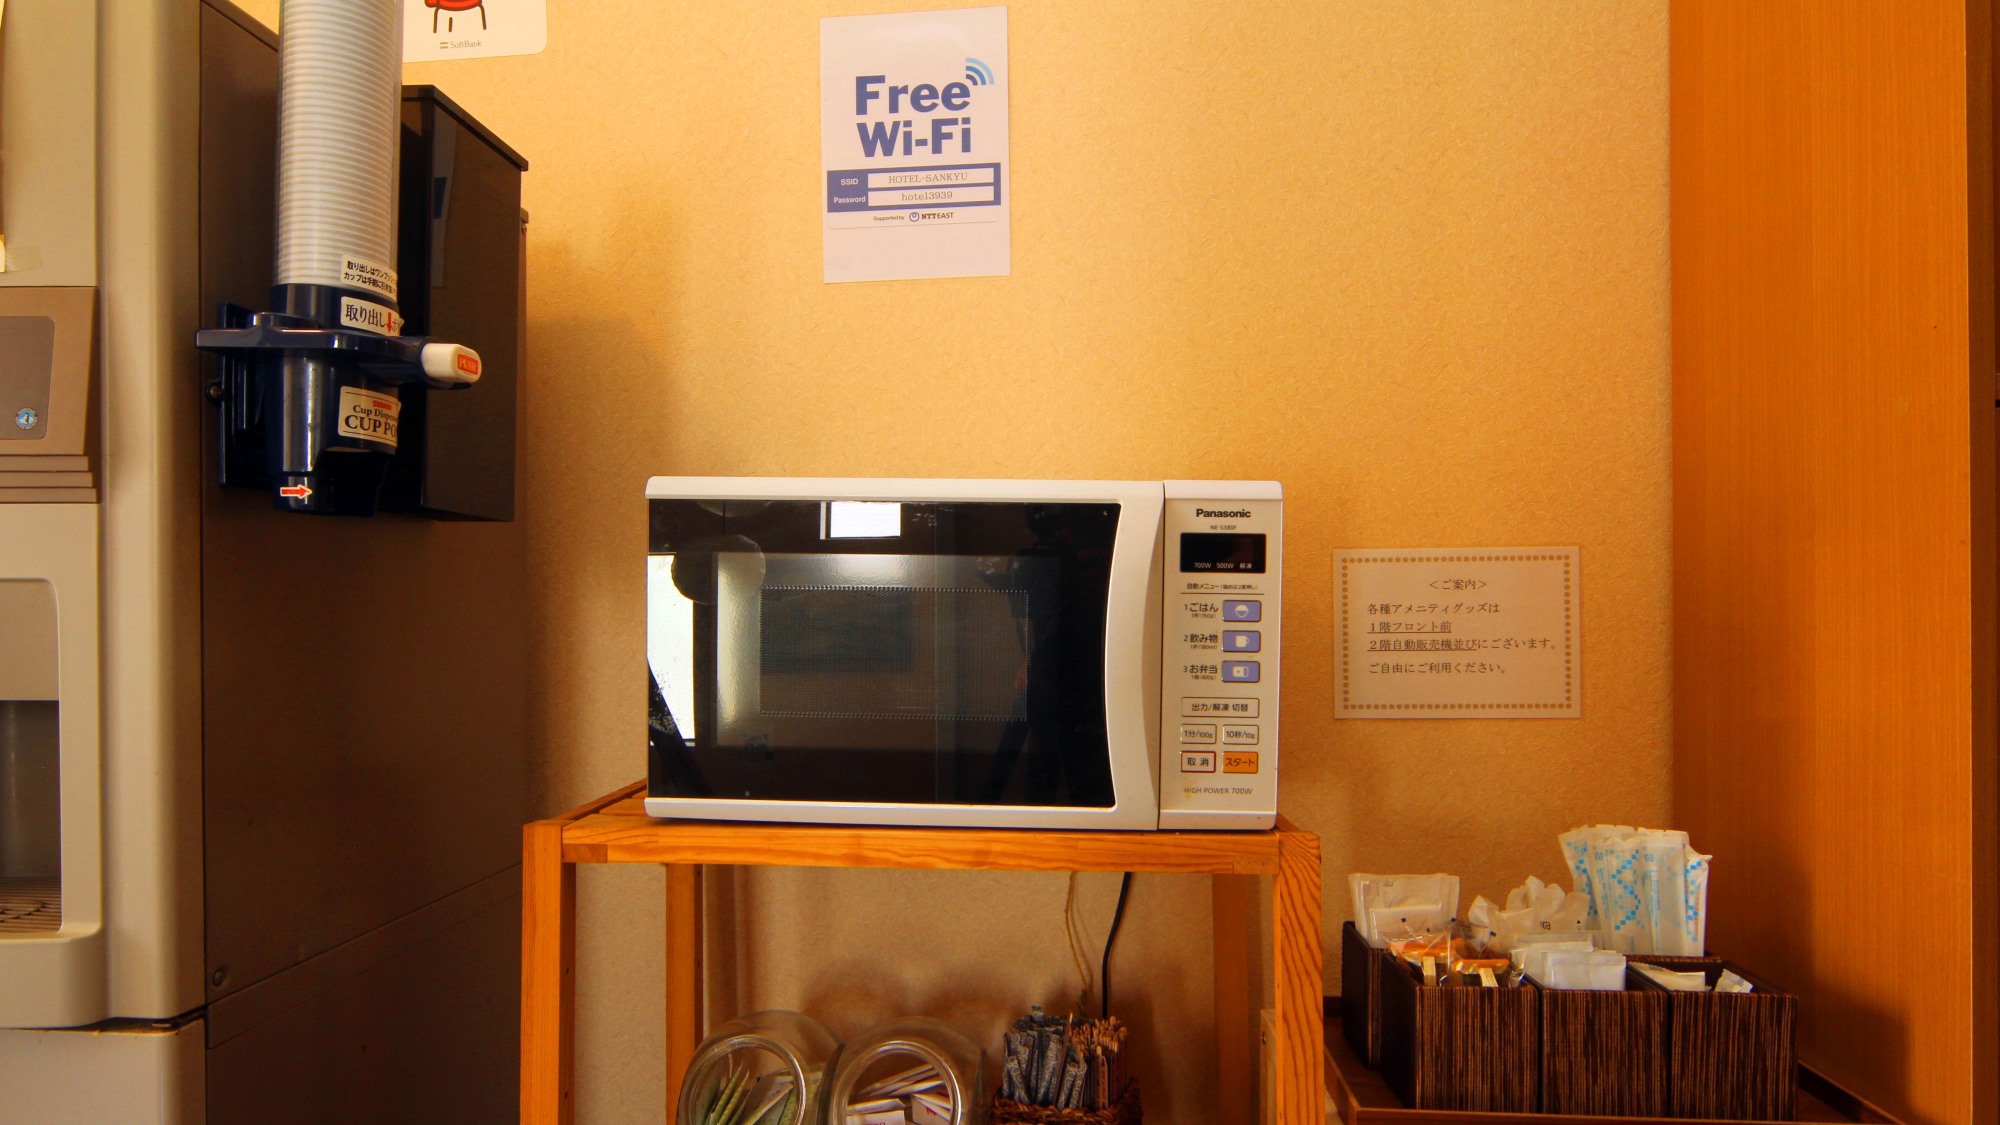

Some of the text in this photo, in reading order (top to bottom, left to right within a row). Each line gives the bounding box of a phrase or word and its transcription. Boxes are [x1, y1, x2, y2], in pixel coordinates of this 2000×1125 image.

[450, 40, 481, 48] SoftBank
[855, 75, 971, 116] Free
[856, 117, 971, 157] Wi-Fi
[840, 172, 968, 186] SSID HOTEL-SANKYU
[833, 191, 953, 204] Password hotel3939
[345, 304, 385, 328] 取り出し
[459, 357, 477, 373] PUSH
[352, 404, 372, 417] Cup
[344, 414, 382, 433] CUP
[1196, 509, 1251, 518] Panasonic
[1429, 579, 1487, 591] ＜ご案内＞
[1190, 602, 1219, 612] ごはん
[1368, 602, 1500, 615] 各種アメニティグッズは
[1370, 621, 1452, 632] 1階フロント前
[1190, 634, 1218, 643] 飲み物
[1369, 638, 1556, 651] 2階自動販売機並びにございます。
[1190, 664, 1218, 674] お弁当
[1369, 662, 1506, 674] ご自由にご利用ください。
[1191, 703, 1248, 712] 出力/解凍 切替
[1184, 730, 1213, 738] 1分/100g
[1226, 731, 1255, 740] 10秒/10g
[1226, 758, 1254, 766] スタート
